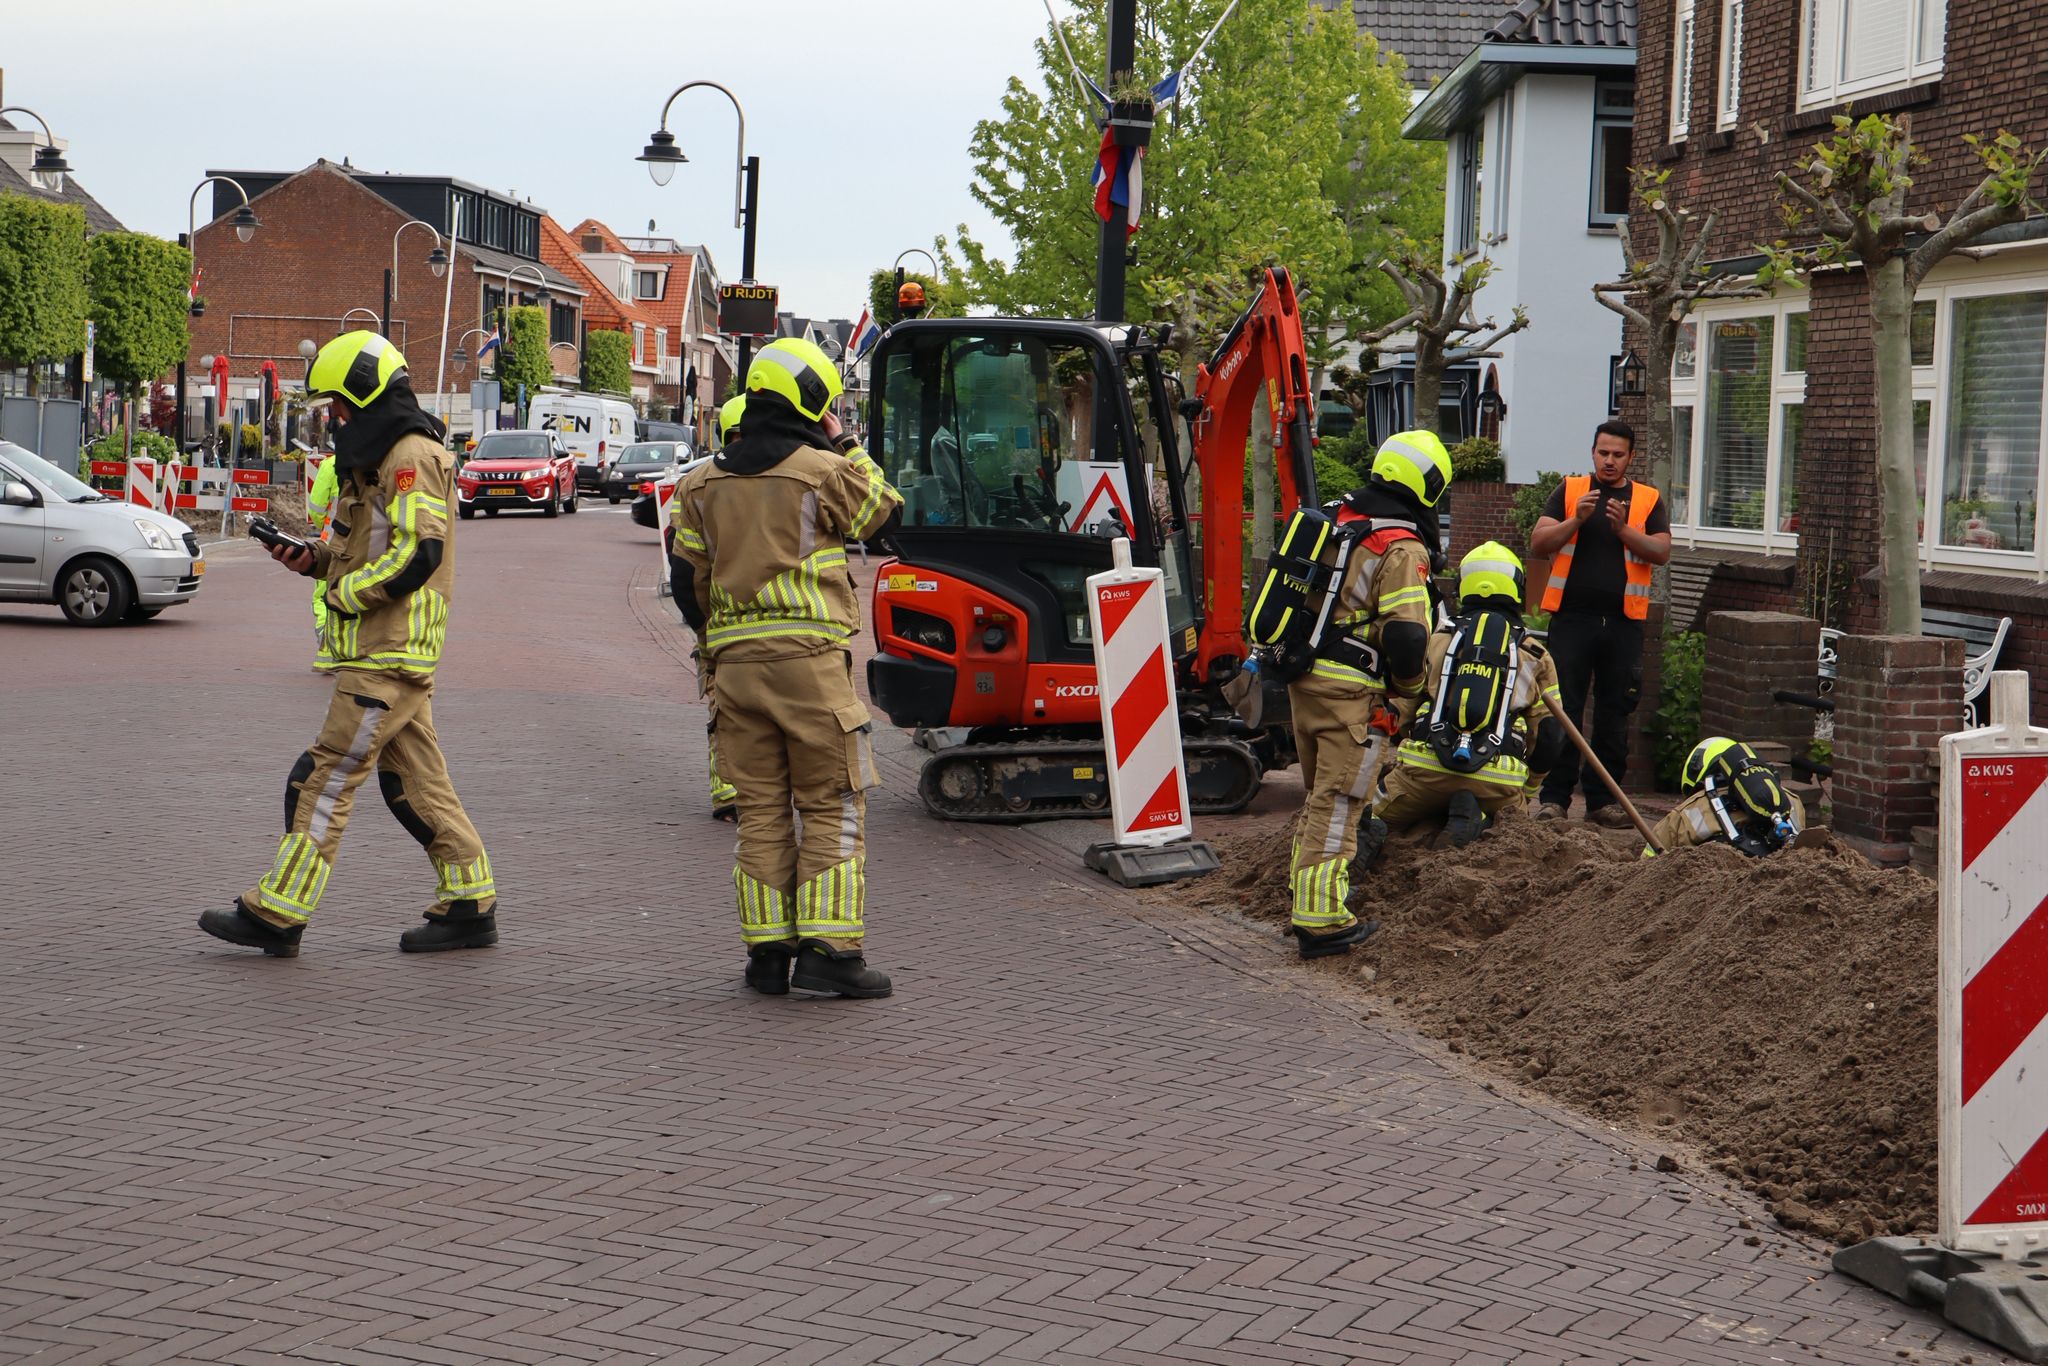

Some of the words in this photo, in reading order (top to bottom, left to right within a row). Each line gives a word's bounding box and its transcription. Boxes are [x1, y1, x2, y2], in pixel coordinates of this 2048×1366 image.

[722, 287, 731, 298] U
[735, 287, 775, 300] RIJDT
[1113, 590, 1130, 599] KWS
[1983, 764, 2014, 777] KWS
[1149, 813, 1167, 823] KWS
[2016, 1202, 2046, 1216] KWS
